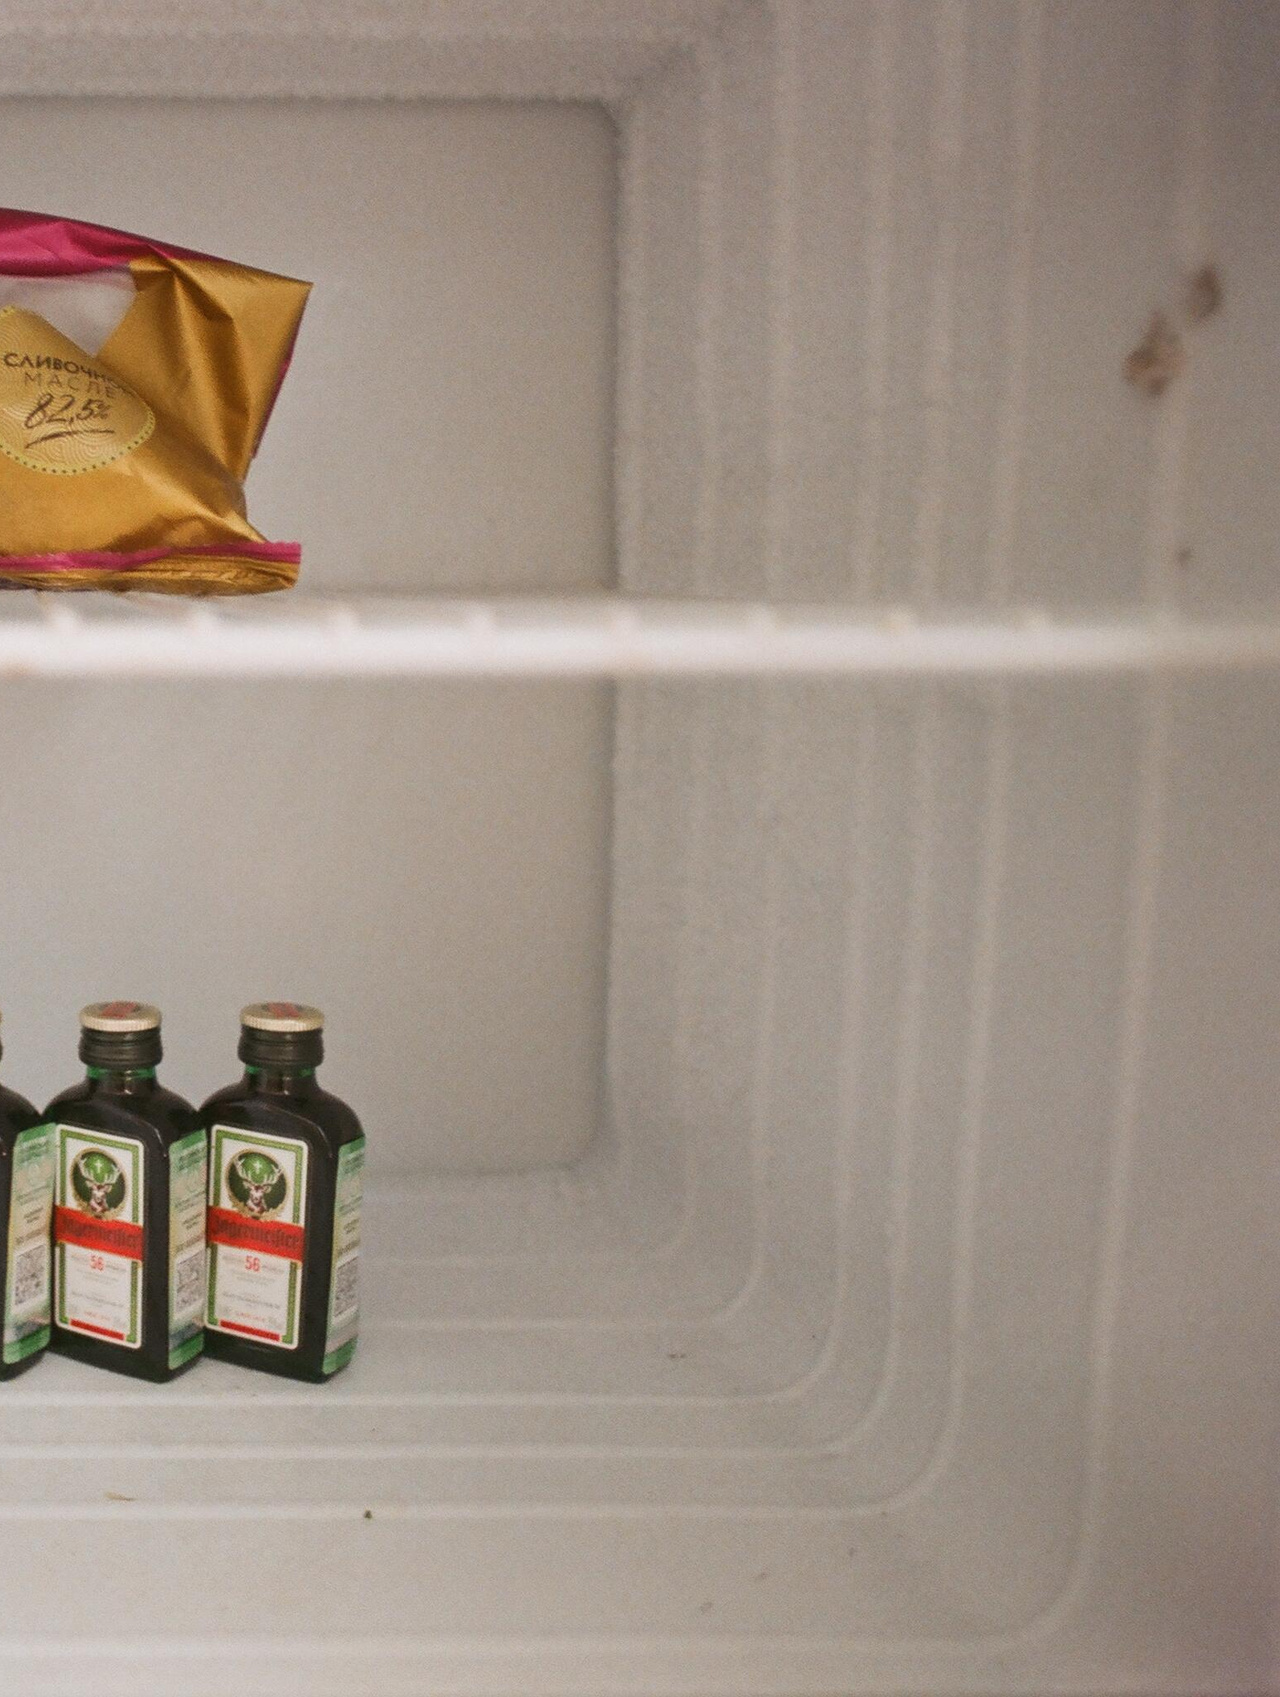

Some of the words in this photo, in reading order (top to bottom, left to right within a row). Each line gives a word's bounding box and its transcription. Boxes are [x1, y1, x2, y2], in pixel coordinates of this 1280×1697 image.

[24, 372, 117, 399] МАСЛЕ
[24, 392, 111, 431] 82,5%
[244, 1255, 261, 1272] 56
